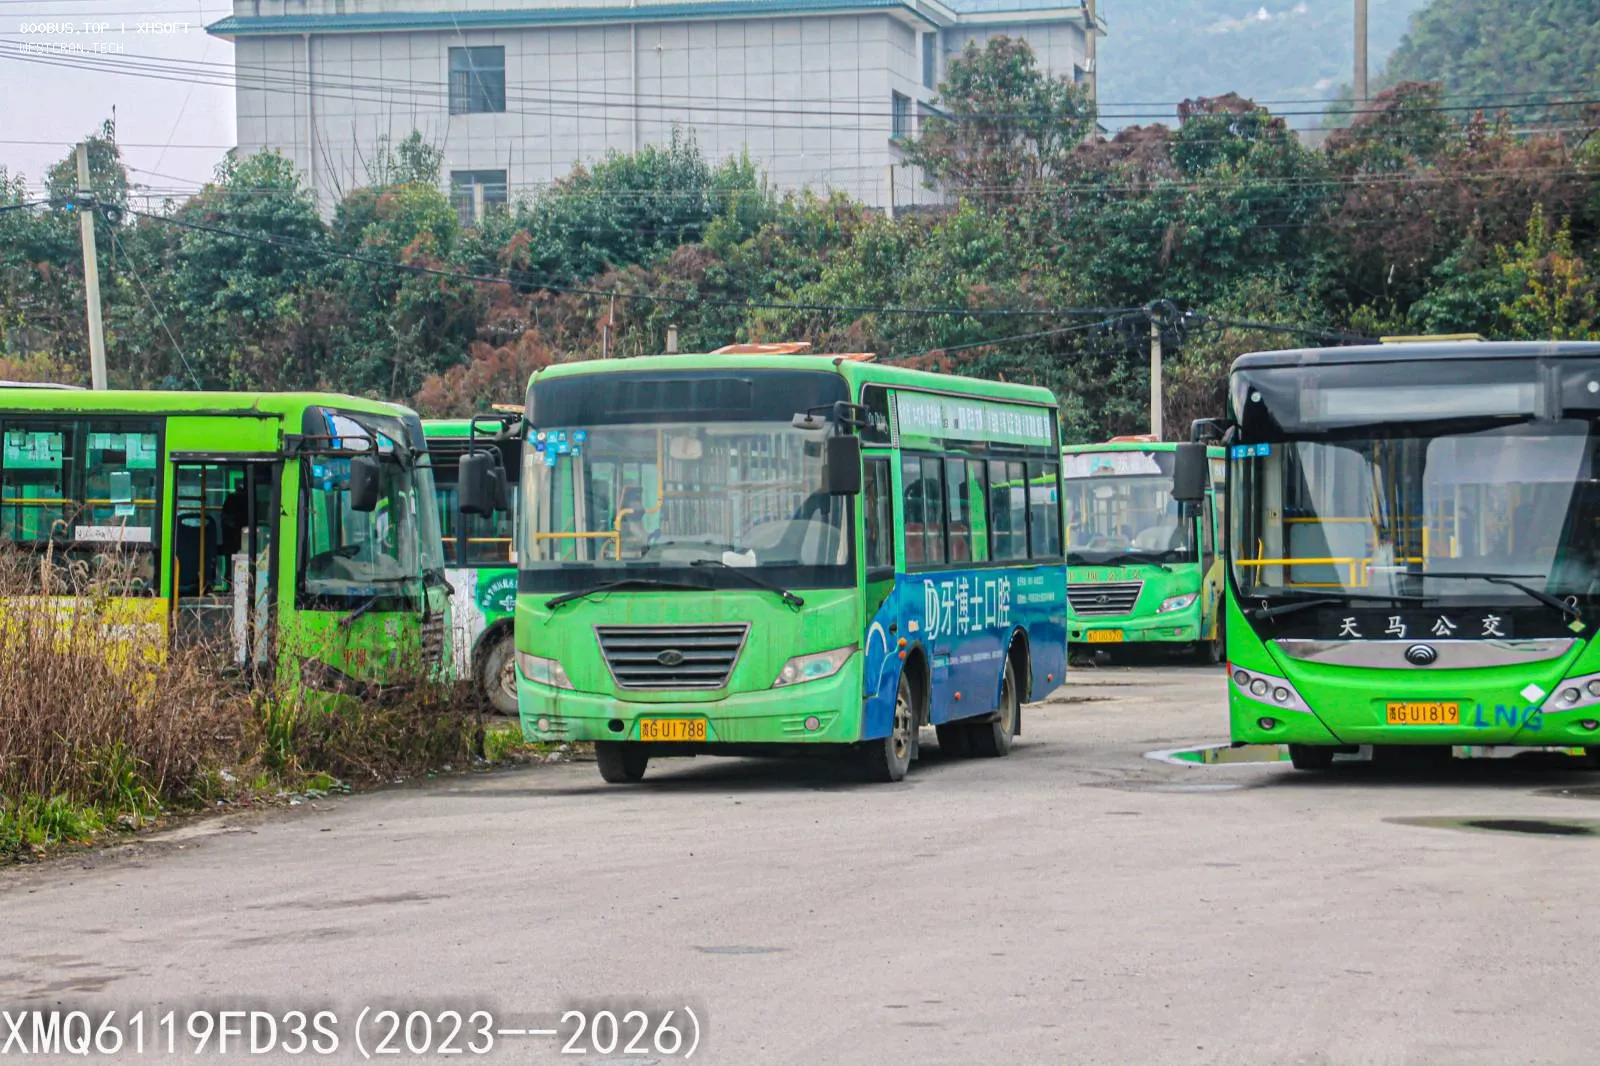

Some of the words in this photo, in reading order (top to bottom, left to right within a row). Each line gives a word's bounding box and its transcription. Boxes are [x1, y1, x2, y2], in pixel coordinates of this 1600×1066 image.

[941, 575, 1011, 636] 牙博士口腔
[1338, 614, 1506, 639] 天马公交
[1473, 703, 1544, 732] LNG
